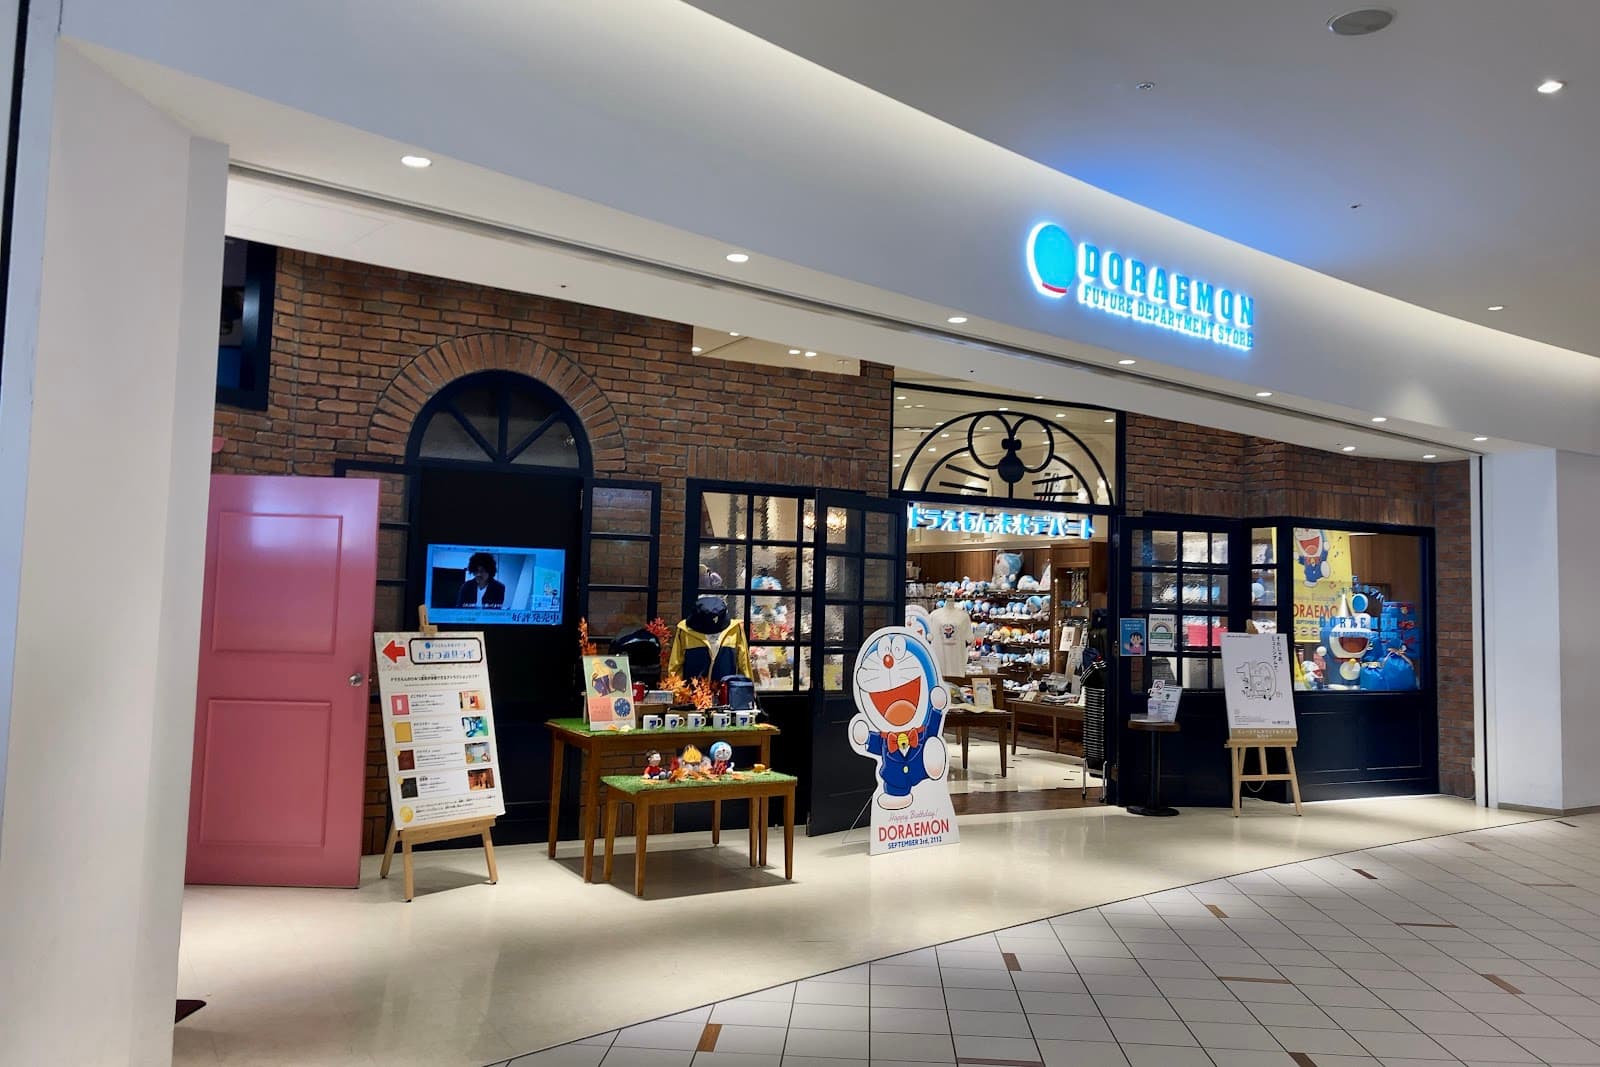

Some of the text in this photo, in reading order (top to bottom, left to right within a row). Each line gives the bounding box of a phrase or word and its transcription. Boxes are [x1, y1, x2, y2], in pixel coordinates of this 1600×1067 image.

[1080, 242, 1254, 328] DORAEMON
[1079, 284, 1254, 350] FUTURE DEPARTMENT STORE
[908, 505, 1095, 539] ドラえもん未来デパート
[879, 818, 950, 842] DORAEMON
[888, 811, 909, 823] Happy
[888, 840, 919, 850] SEPTEMBER
